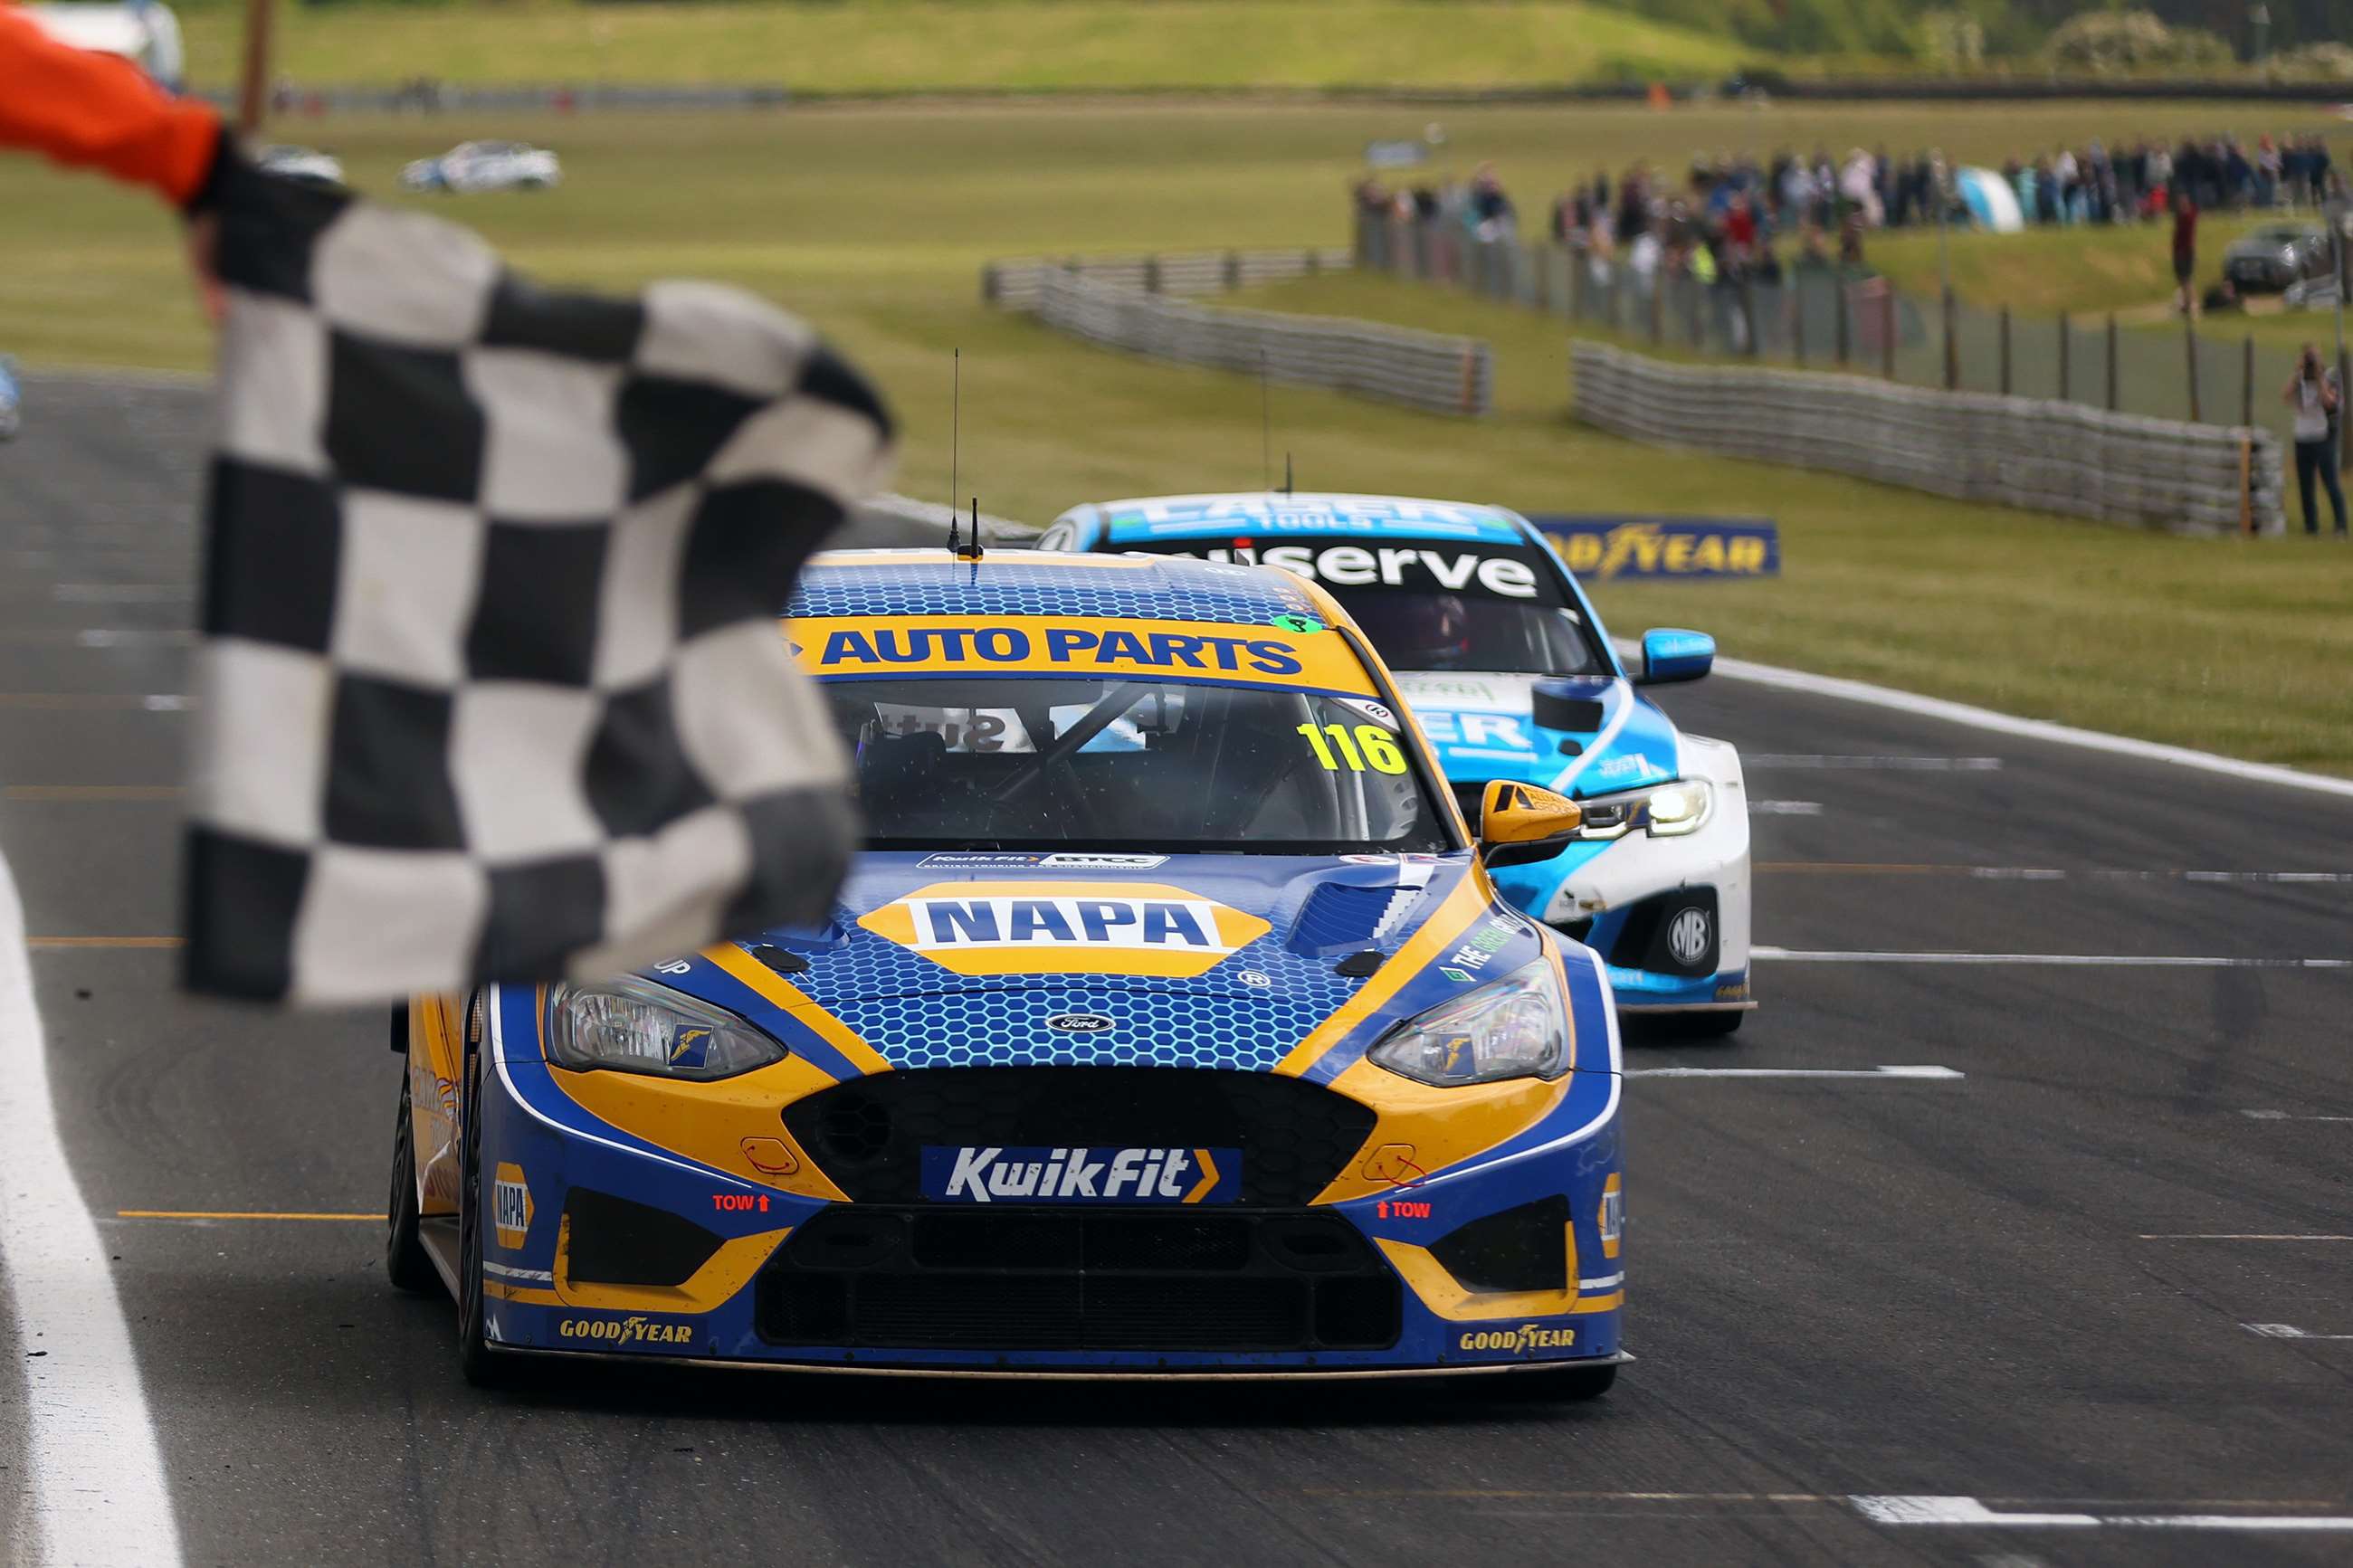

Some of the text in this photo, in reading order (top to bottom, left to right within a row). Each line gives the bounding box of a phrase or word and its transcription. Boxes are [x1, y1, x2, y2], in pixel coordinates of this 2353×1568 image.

[1256, 514, 1372, 529] TOOLS
[1541, 523, 1764, 580] DYEAR
[1170, 537, 1538, 598] iserve
[820, 628, 1302, 675] AUTO PARTS
[1297, 723, 1408, 775] 116
[925, 900, 1210, 946] NAPA
[1451, 945, 1492, 970] THE
[1060, 1017, 1100, 1030] Ford
[497, 1183, 525, 1227] NAPA
[712, 1194, 755, 1211] TOW
[1392, 1202, 1432, 1218] TOW
[559, 1316, 693, 1346] GOODYEAR
[1459, 1324, 1577, 1354] GOODYEAR
